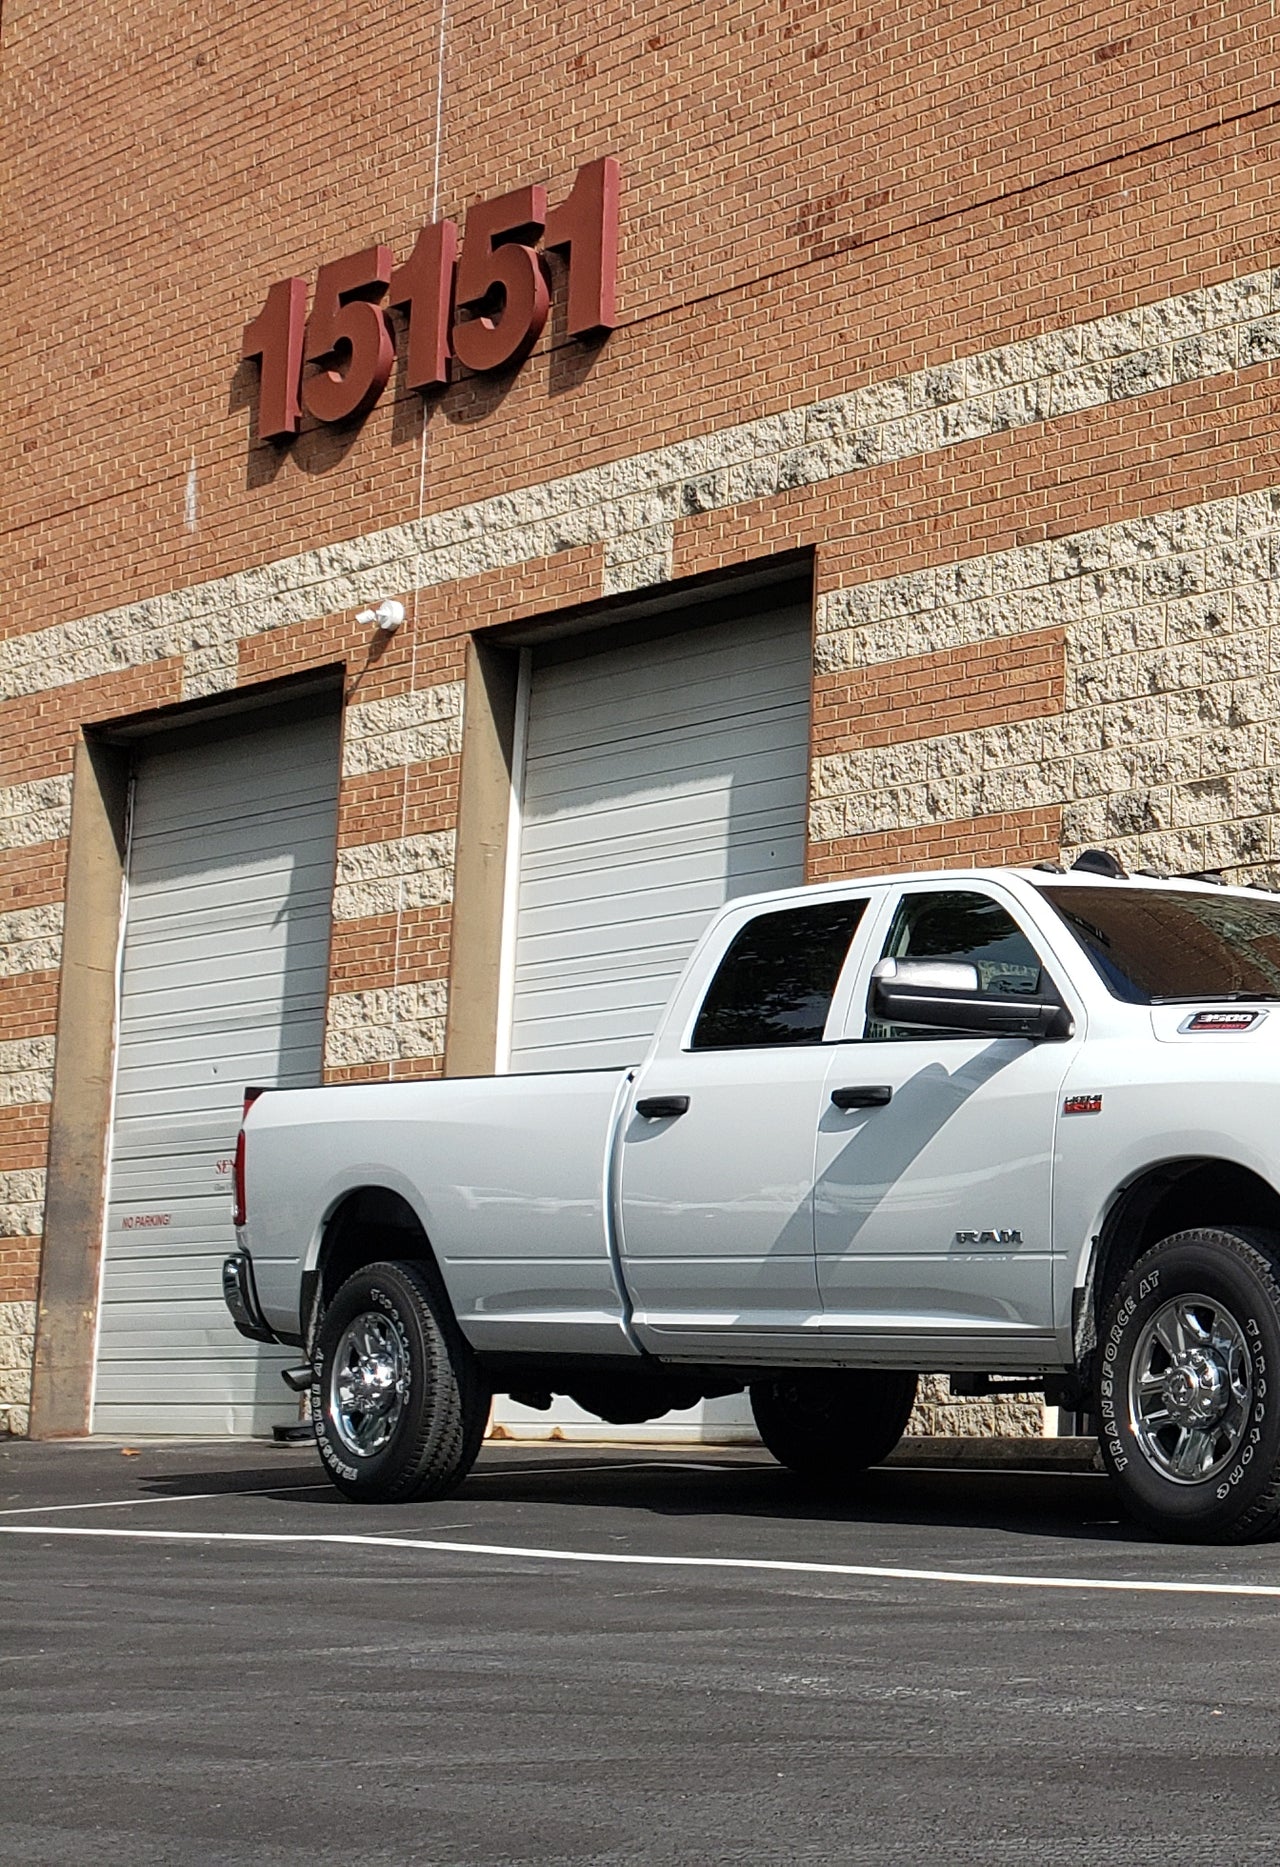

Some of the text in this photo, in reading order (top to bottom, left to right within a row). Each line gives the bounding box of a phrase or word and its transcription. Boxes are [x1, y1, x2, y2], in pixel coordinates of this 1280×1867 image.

[243, 157, 620, 442] 15151
[955, 1229, 1024, 1243] RAM
[1101, 1270, 1160, 1472] TRANSFORCE AT
